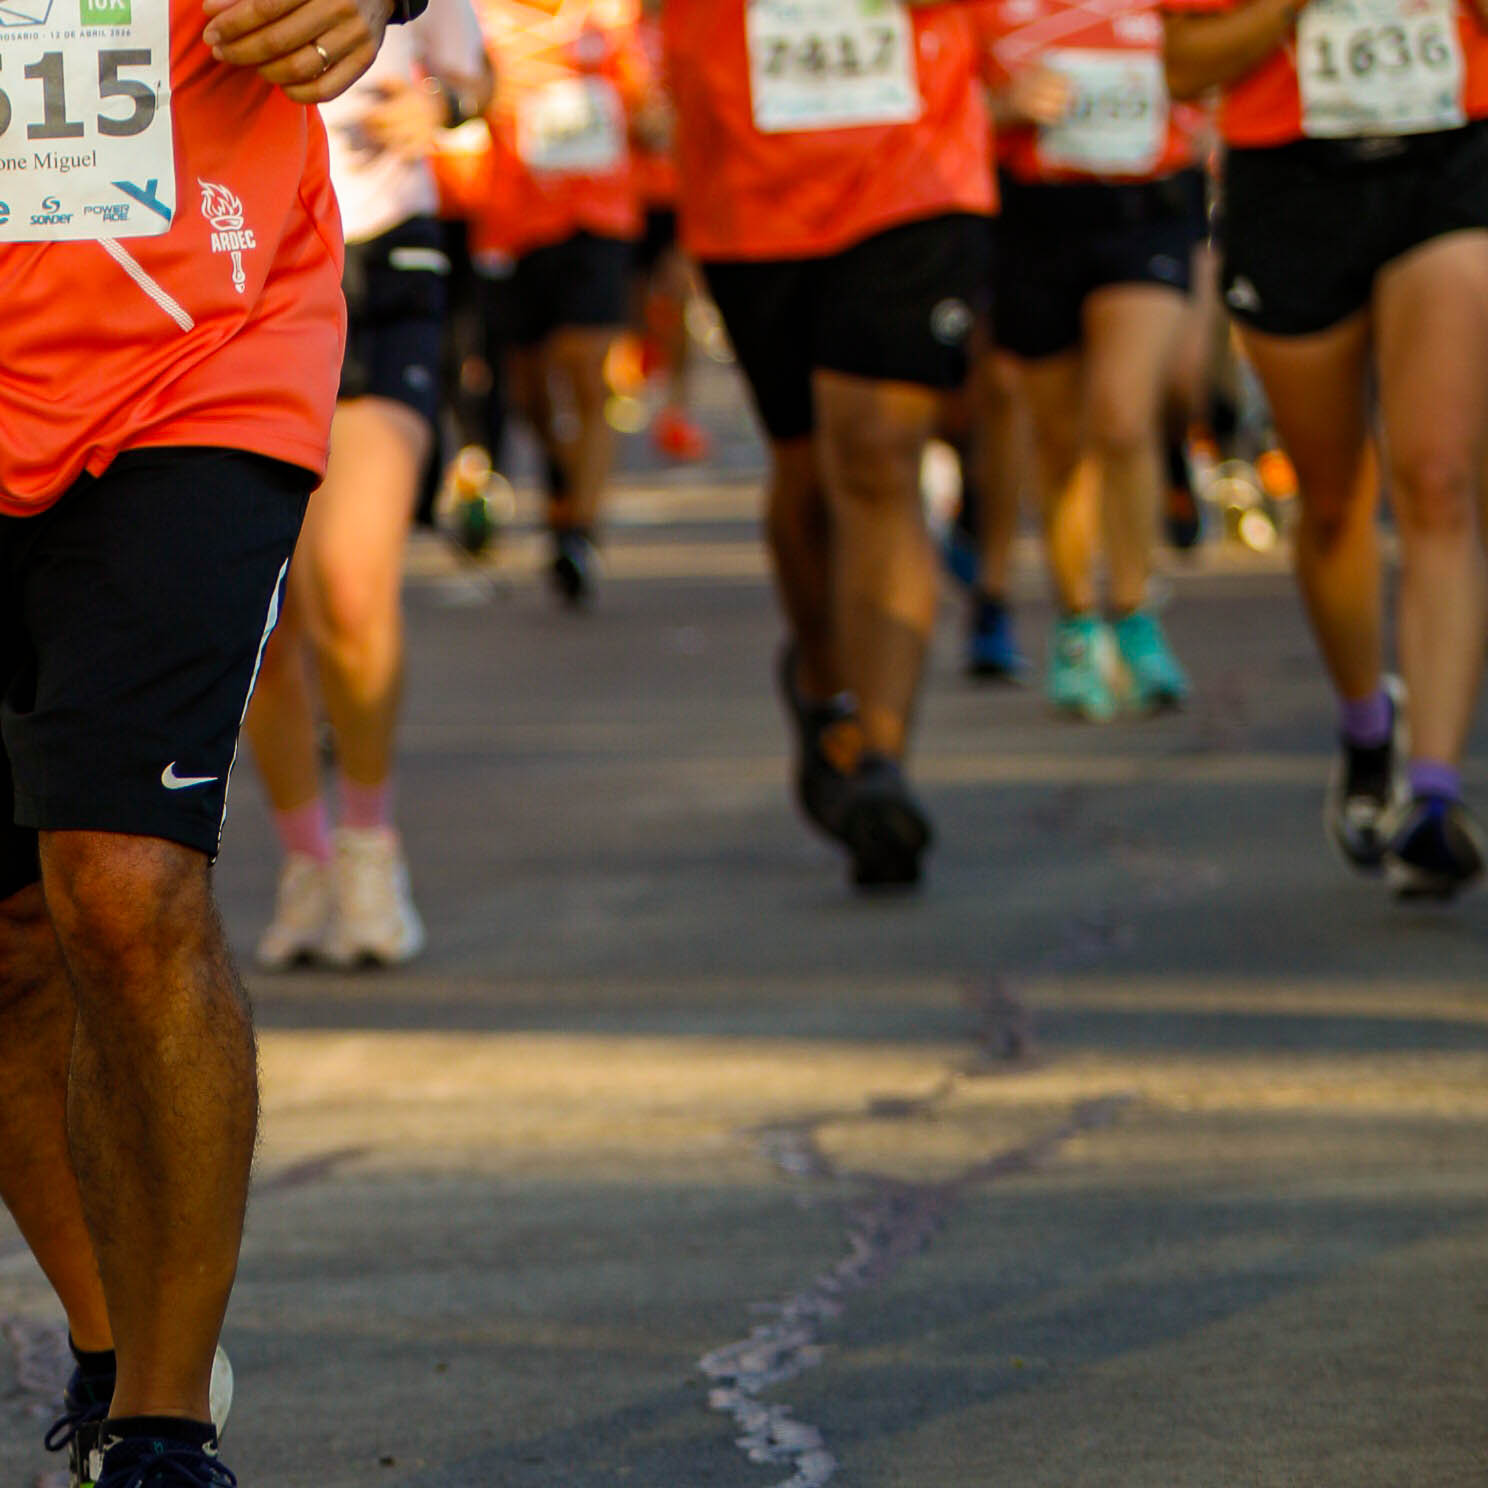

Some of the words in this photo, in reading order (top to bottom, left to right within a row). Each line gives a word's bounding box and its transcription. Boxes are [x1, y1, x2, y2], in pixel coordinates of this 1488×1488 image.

[64, 31, 75, 39] DE
[80, 30, 106, 38] ABRIL
[33, 149, 97, 173] Miguel
[83, 203, 130, 215] POWER
[210, 229, 257, 253] ARDEC
